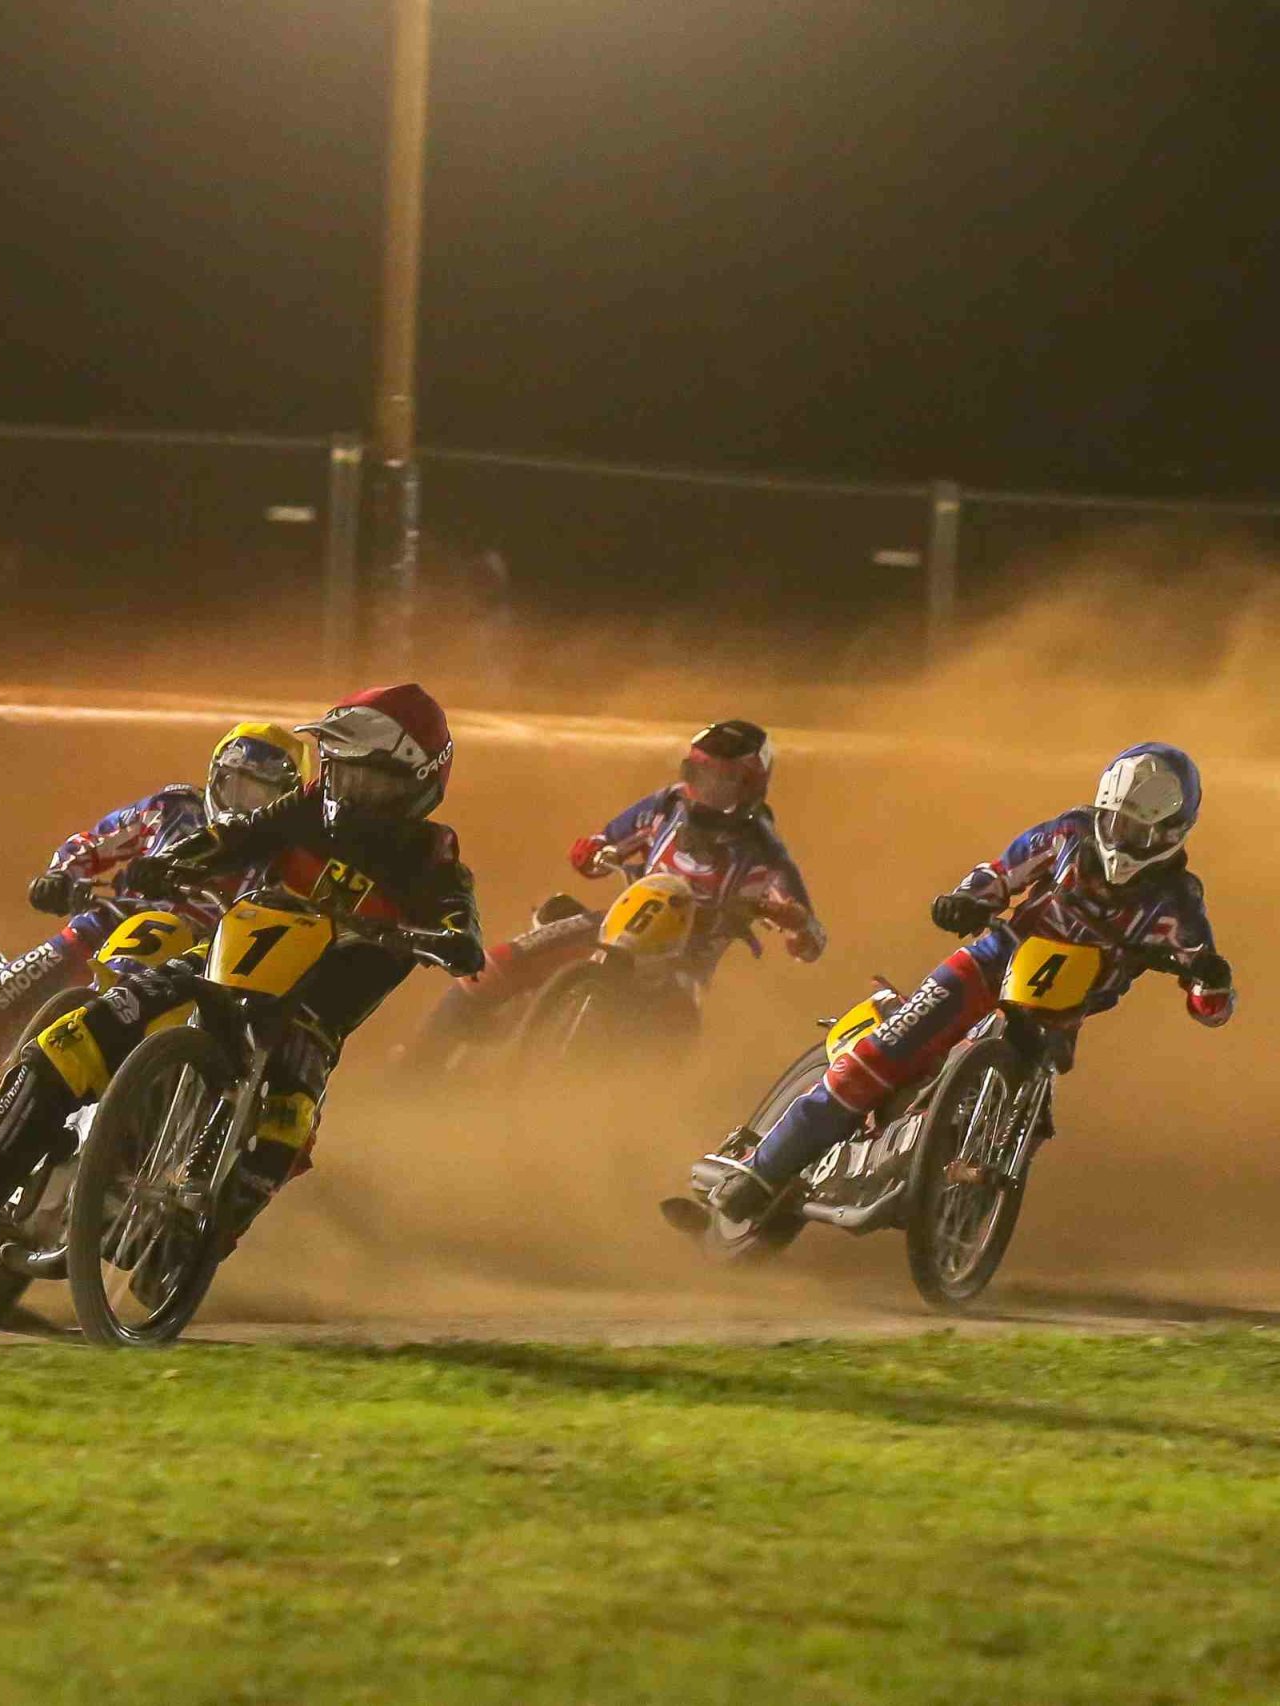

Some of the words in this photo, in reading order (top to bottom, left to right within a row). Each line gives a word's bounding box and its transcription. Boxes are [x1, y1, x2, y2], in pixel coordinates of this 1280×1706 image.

[416, 741, 452, 780] OAKLE
[116, 919, 179, 956] 5
[624, 899, 663, 933] 6
[231, 925, 292, 976] 1
[1027, 953, 1070, 998] 4
[873, 977, 938, 1039] HAGON
[882, 986, 951, 1046] SHOCKS
